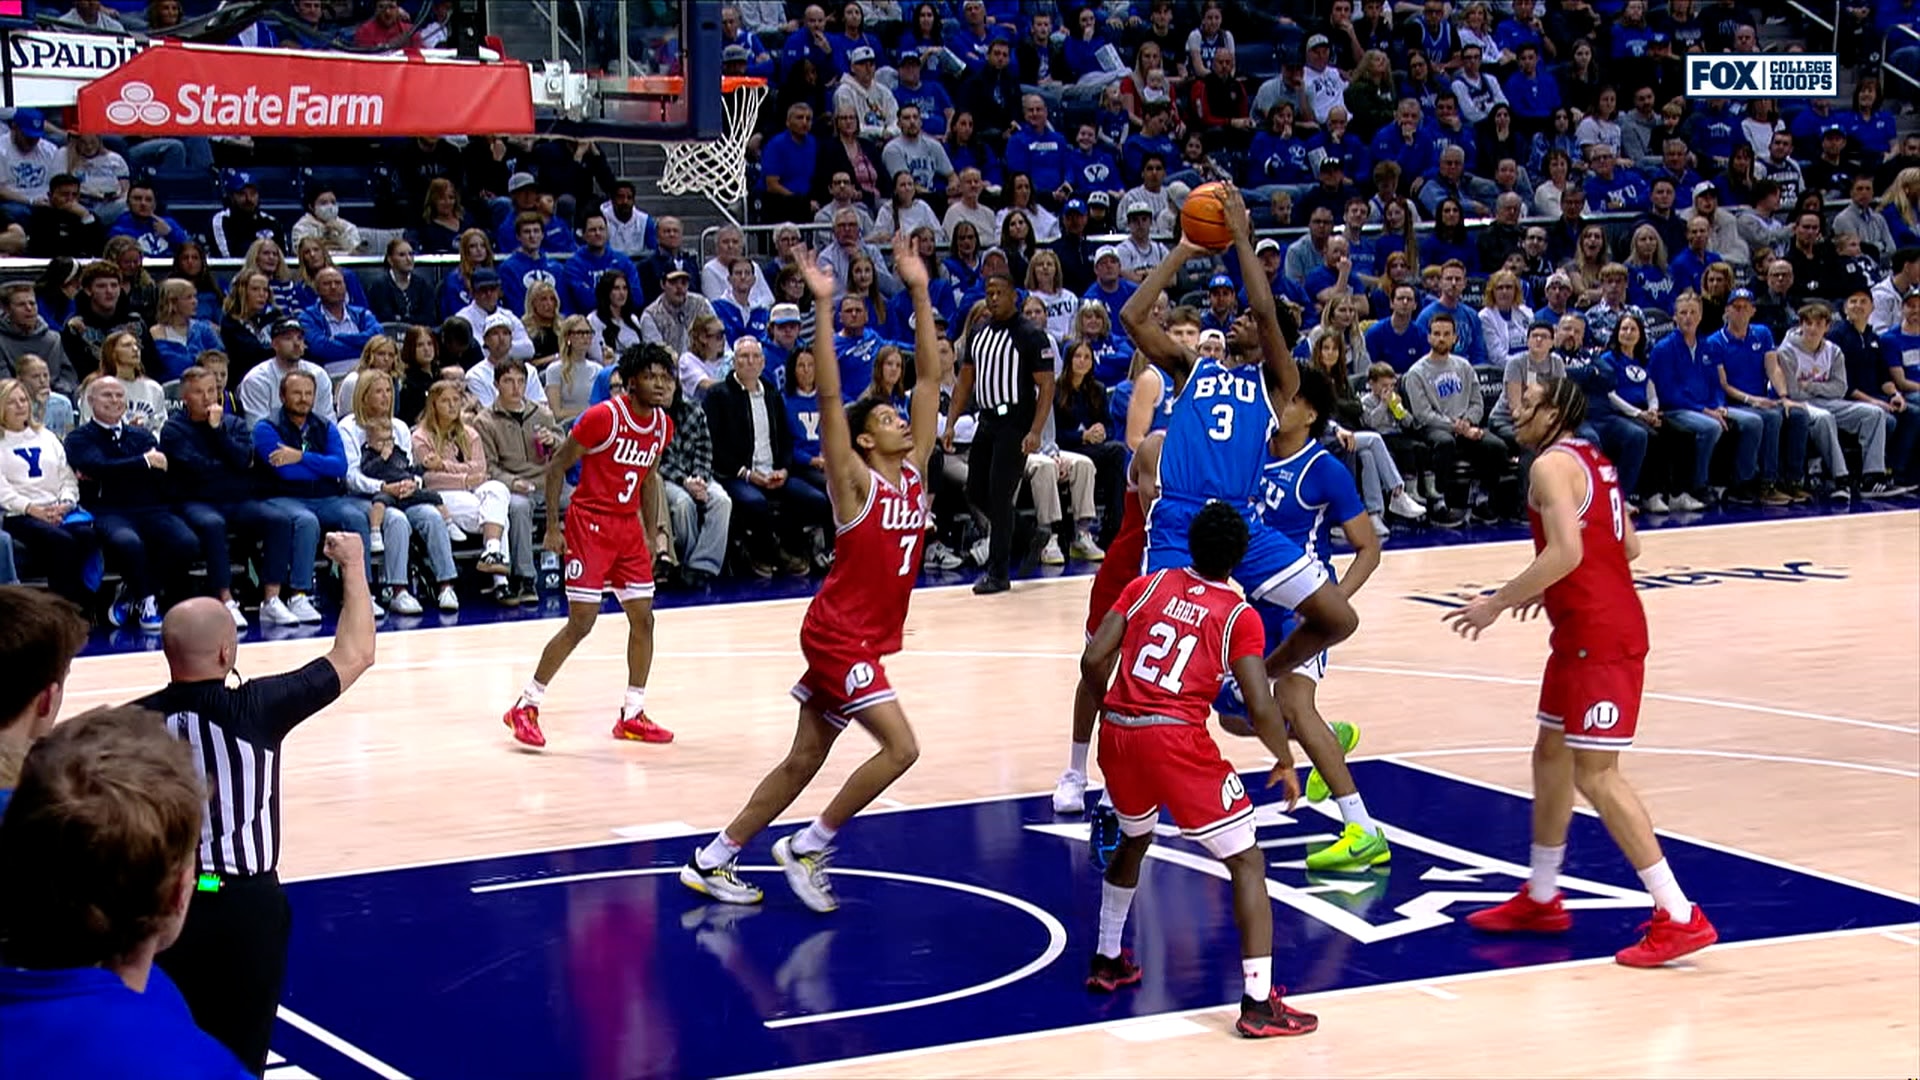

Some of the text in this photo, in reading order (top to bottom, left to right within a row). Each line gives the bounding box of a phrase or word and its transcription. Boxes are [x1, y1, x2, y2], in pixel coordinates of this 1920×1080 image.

[1194, 371, 1256, 403] BYU
[798, 412, 820, 441] Y
[1208, 404, 1235, 441] 3
[13, 447, 43, 478] Y
[613, 437, 658, 467] Utah
[618, 471, 638, 503] 3
[898, 534, 918, 576] 7
[1162, 595, 1209, 628] ABBEY
[1131, 621, 1198, 694] 21
